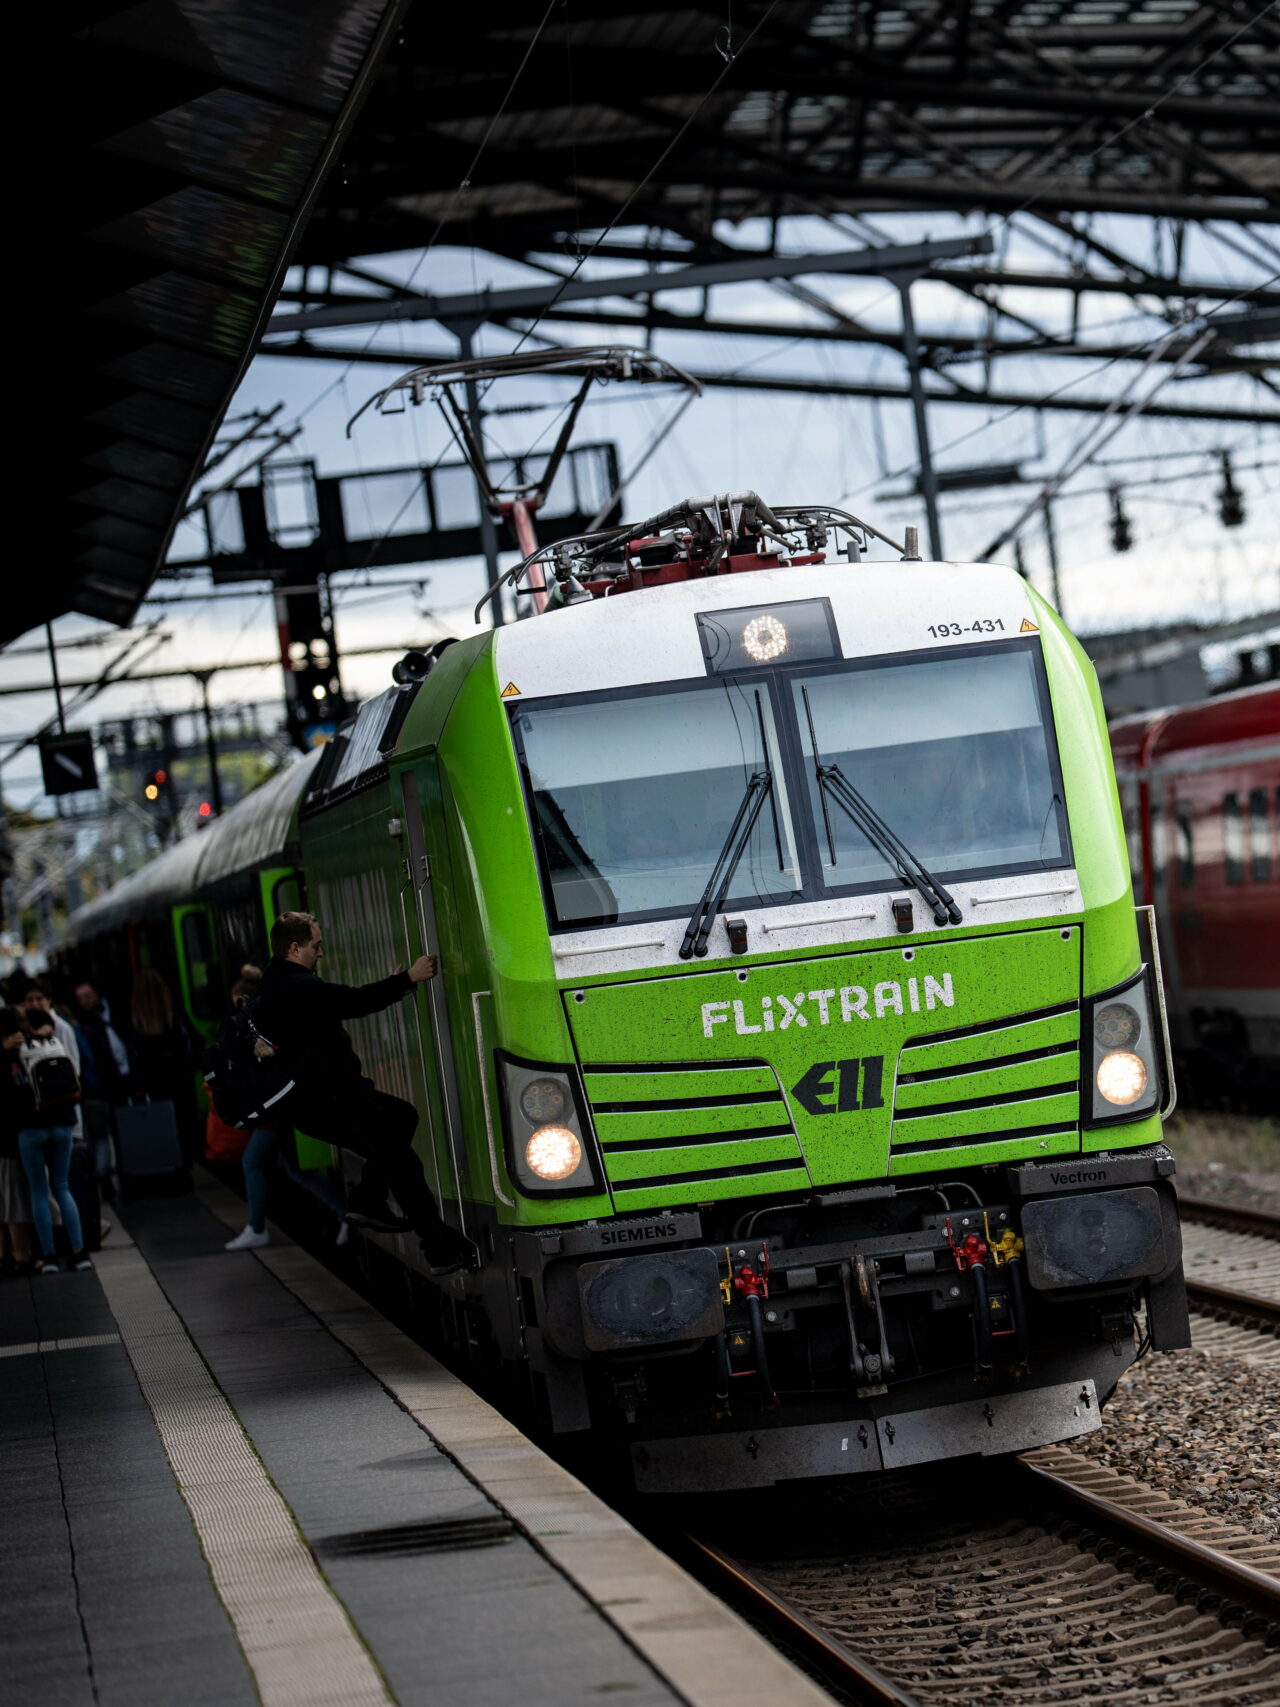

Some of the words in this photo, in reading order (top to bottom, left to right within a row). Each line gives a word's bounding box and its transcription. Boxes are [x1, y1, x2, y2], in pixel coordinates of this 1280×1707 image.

[927, 618, 1005, 639] 193-431
[1050, 1169, 1107, 1186] Vectron
[600, 1223, 677, 1245] SIEMENS
